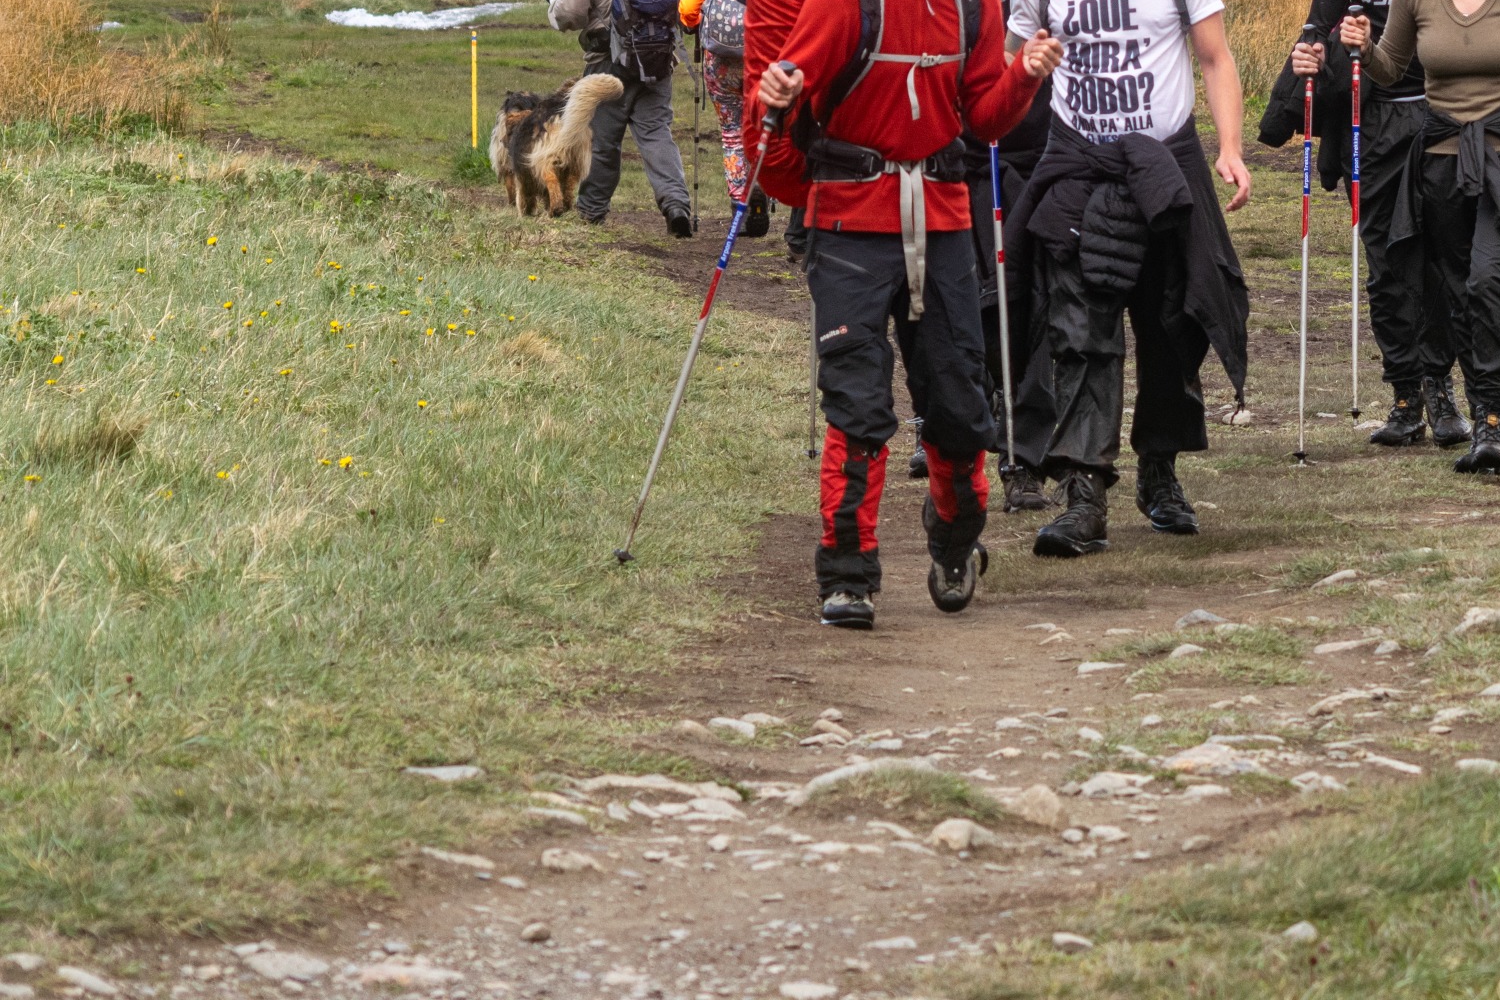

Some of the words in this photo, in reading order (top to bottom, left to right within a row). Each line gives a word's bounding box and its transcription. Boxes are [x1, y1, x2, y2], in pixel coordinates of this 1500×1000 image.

[1065, 71, 1154, 115] BOBO?
[1124, 111, 1154, 132] ALLÁ
[726, 210, 743, 240] Trekking
